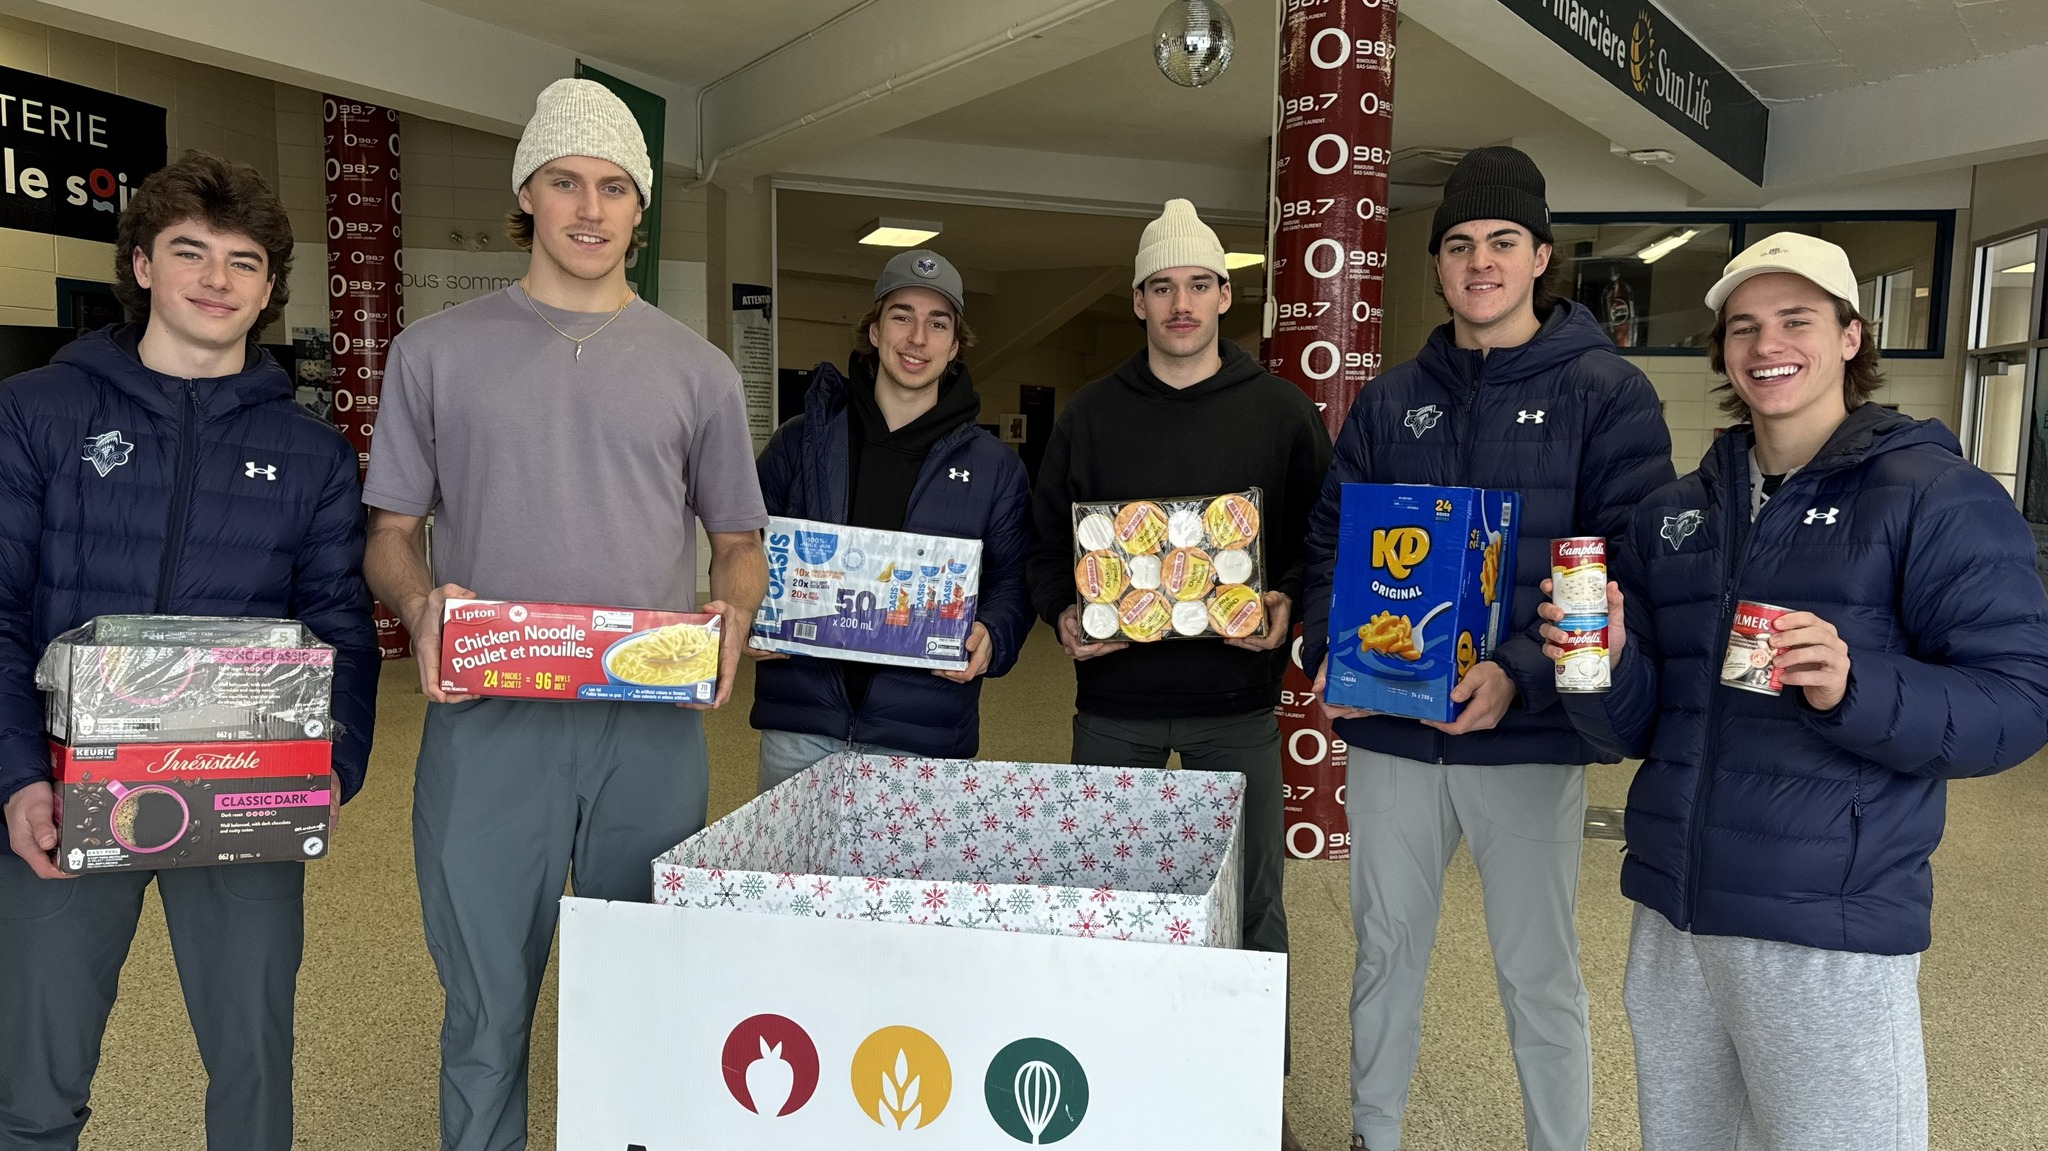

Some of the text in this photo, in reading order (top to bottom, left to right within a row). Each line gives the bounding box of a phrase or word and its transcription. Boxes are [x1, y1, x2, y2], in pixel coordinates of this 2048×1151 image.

[1310, 27, 1351, 69] O
[1656, 48, 1685, 112] Sun
[1686, 71, 1712, 130] Life
[1286, 92, 1338, 116] 98,7
[0, 93, 108, 149] TERIE
[1307, 133, 1392, 175] O 98,7
[4, 147, 49, 199] le
[1283, 198, 1335, 218] 98,7
[1304, 238, 1345, 279] O
[403, 273, 439, 289] ous
[1279, 301, 1331, 318] 98,7
[1300, 340, 1382, 380] O 98,7
[1435, 499, 1452, 512] 24
[1372, 526, 1430, 579] KD
[767, 533, 791, 600] OASIS
[795, 567, 810, 578] 10x
[791, 589, 807, 599] 20x
[792, 578, 809, 588] 20x
[943, 579, 953, 605] OASIS
[1371, 580, 1423, 600] ORIGINAL
[835, 588, 877, 615] 50
[888, 586, 899, 612] OASIS
[916, 583, 926, 609] OASIS
[455, 608, 496, 621] Lipton
[840, 616, 858, 629] 200
[860, 620, 873, 631] mL
[1734, 612, 1770, 631] YLMER
[454, 624, 586, 654] Chicken Noodle
[451, 641, 594, 674] Poulet et nouilles
[483, 669, 499, 688] 24
[500, 681, 522, 689] SACHETS
[535, 671, 552, 690] 96
[1280, 690, 1316, 707] 8,7
[76, 748, 115, 756] KEURIG
[1288, 728, 1328, 766] O
[221, 793, 308, 807] CLASSIC DARK
[1285, 822, 1325, 859] O
[218, 853, 229, 861] 662
